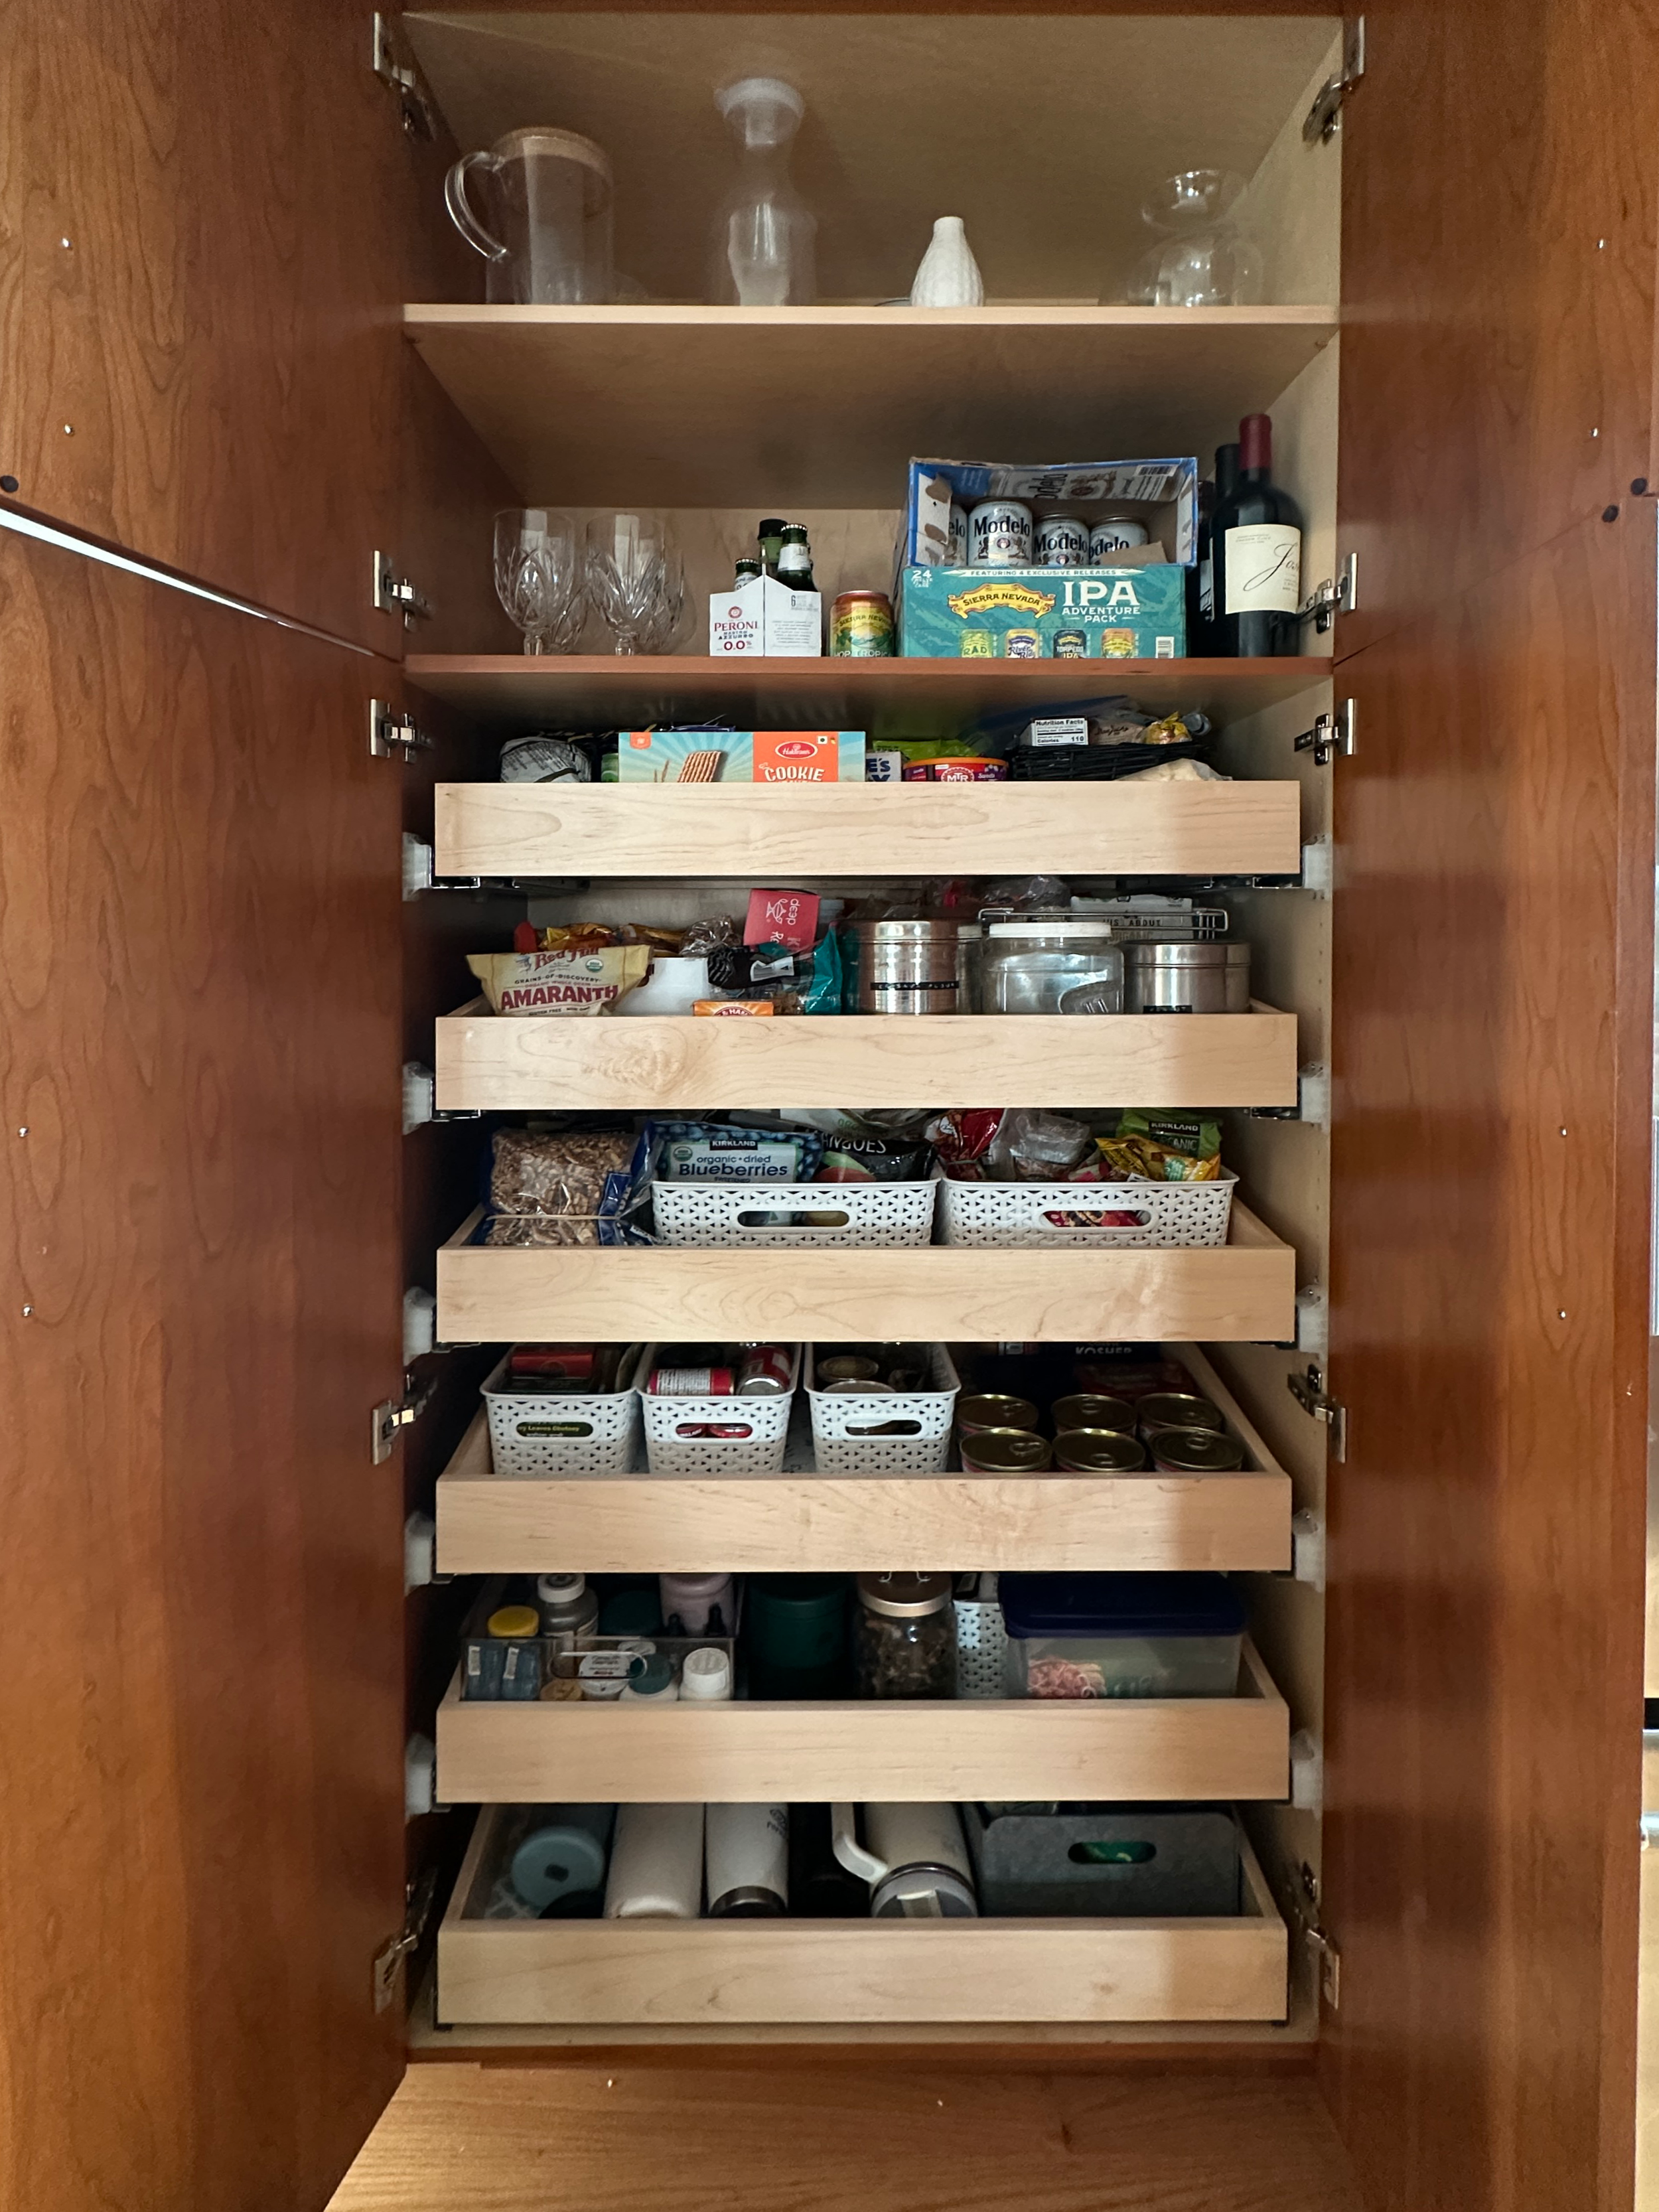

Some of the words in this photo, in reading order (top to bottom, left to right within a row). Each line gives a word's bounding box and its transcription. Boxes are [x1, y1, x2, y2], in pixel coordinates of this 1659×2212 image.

[974, 515, 1030, 538] Modelo
[1034, 532, 1088, 555] Modelo
[1089, 536, 1129, 559] odelo
[912, 569, 932, 579] 24
[791, 595, 796, 607] 6
[962, 593, 999, 607] SIERRA
[1001, 592, 1041, 606] NEVADA
[1062, 581, 1141, 607] IPA
[1062, 607, 1141, 615] ADVENTURE
[1084, 615, 1117, 623] PACK
[714, 621, 758, 632] PERONI
[964, 646, 987, 655] RAD
[764, 765, 826, 782] COOKIE
[947, 772, 969, 782] MTR
[534, 949, 565, 972] Red
[502, 985, 618, 1010] AMARANTH
[1151, 1122, 1198, 1132] KIRKLAND
[820, 1132, 887, 1153] ANGOES
[696, 1155, 737, 1165] organic
[679, 1163, 788, 1177] Blueberries
